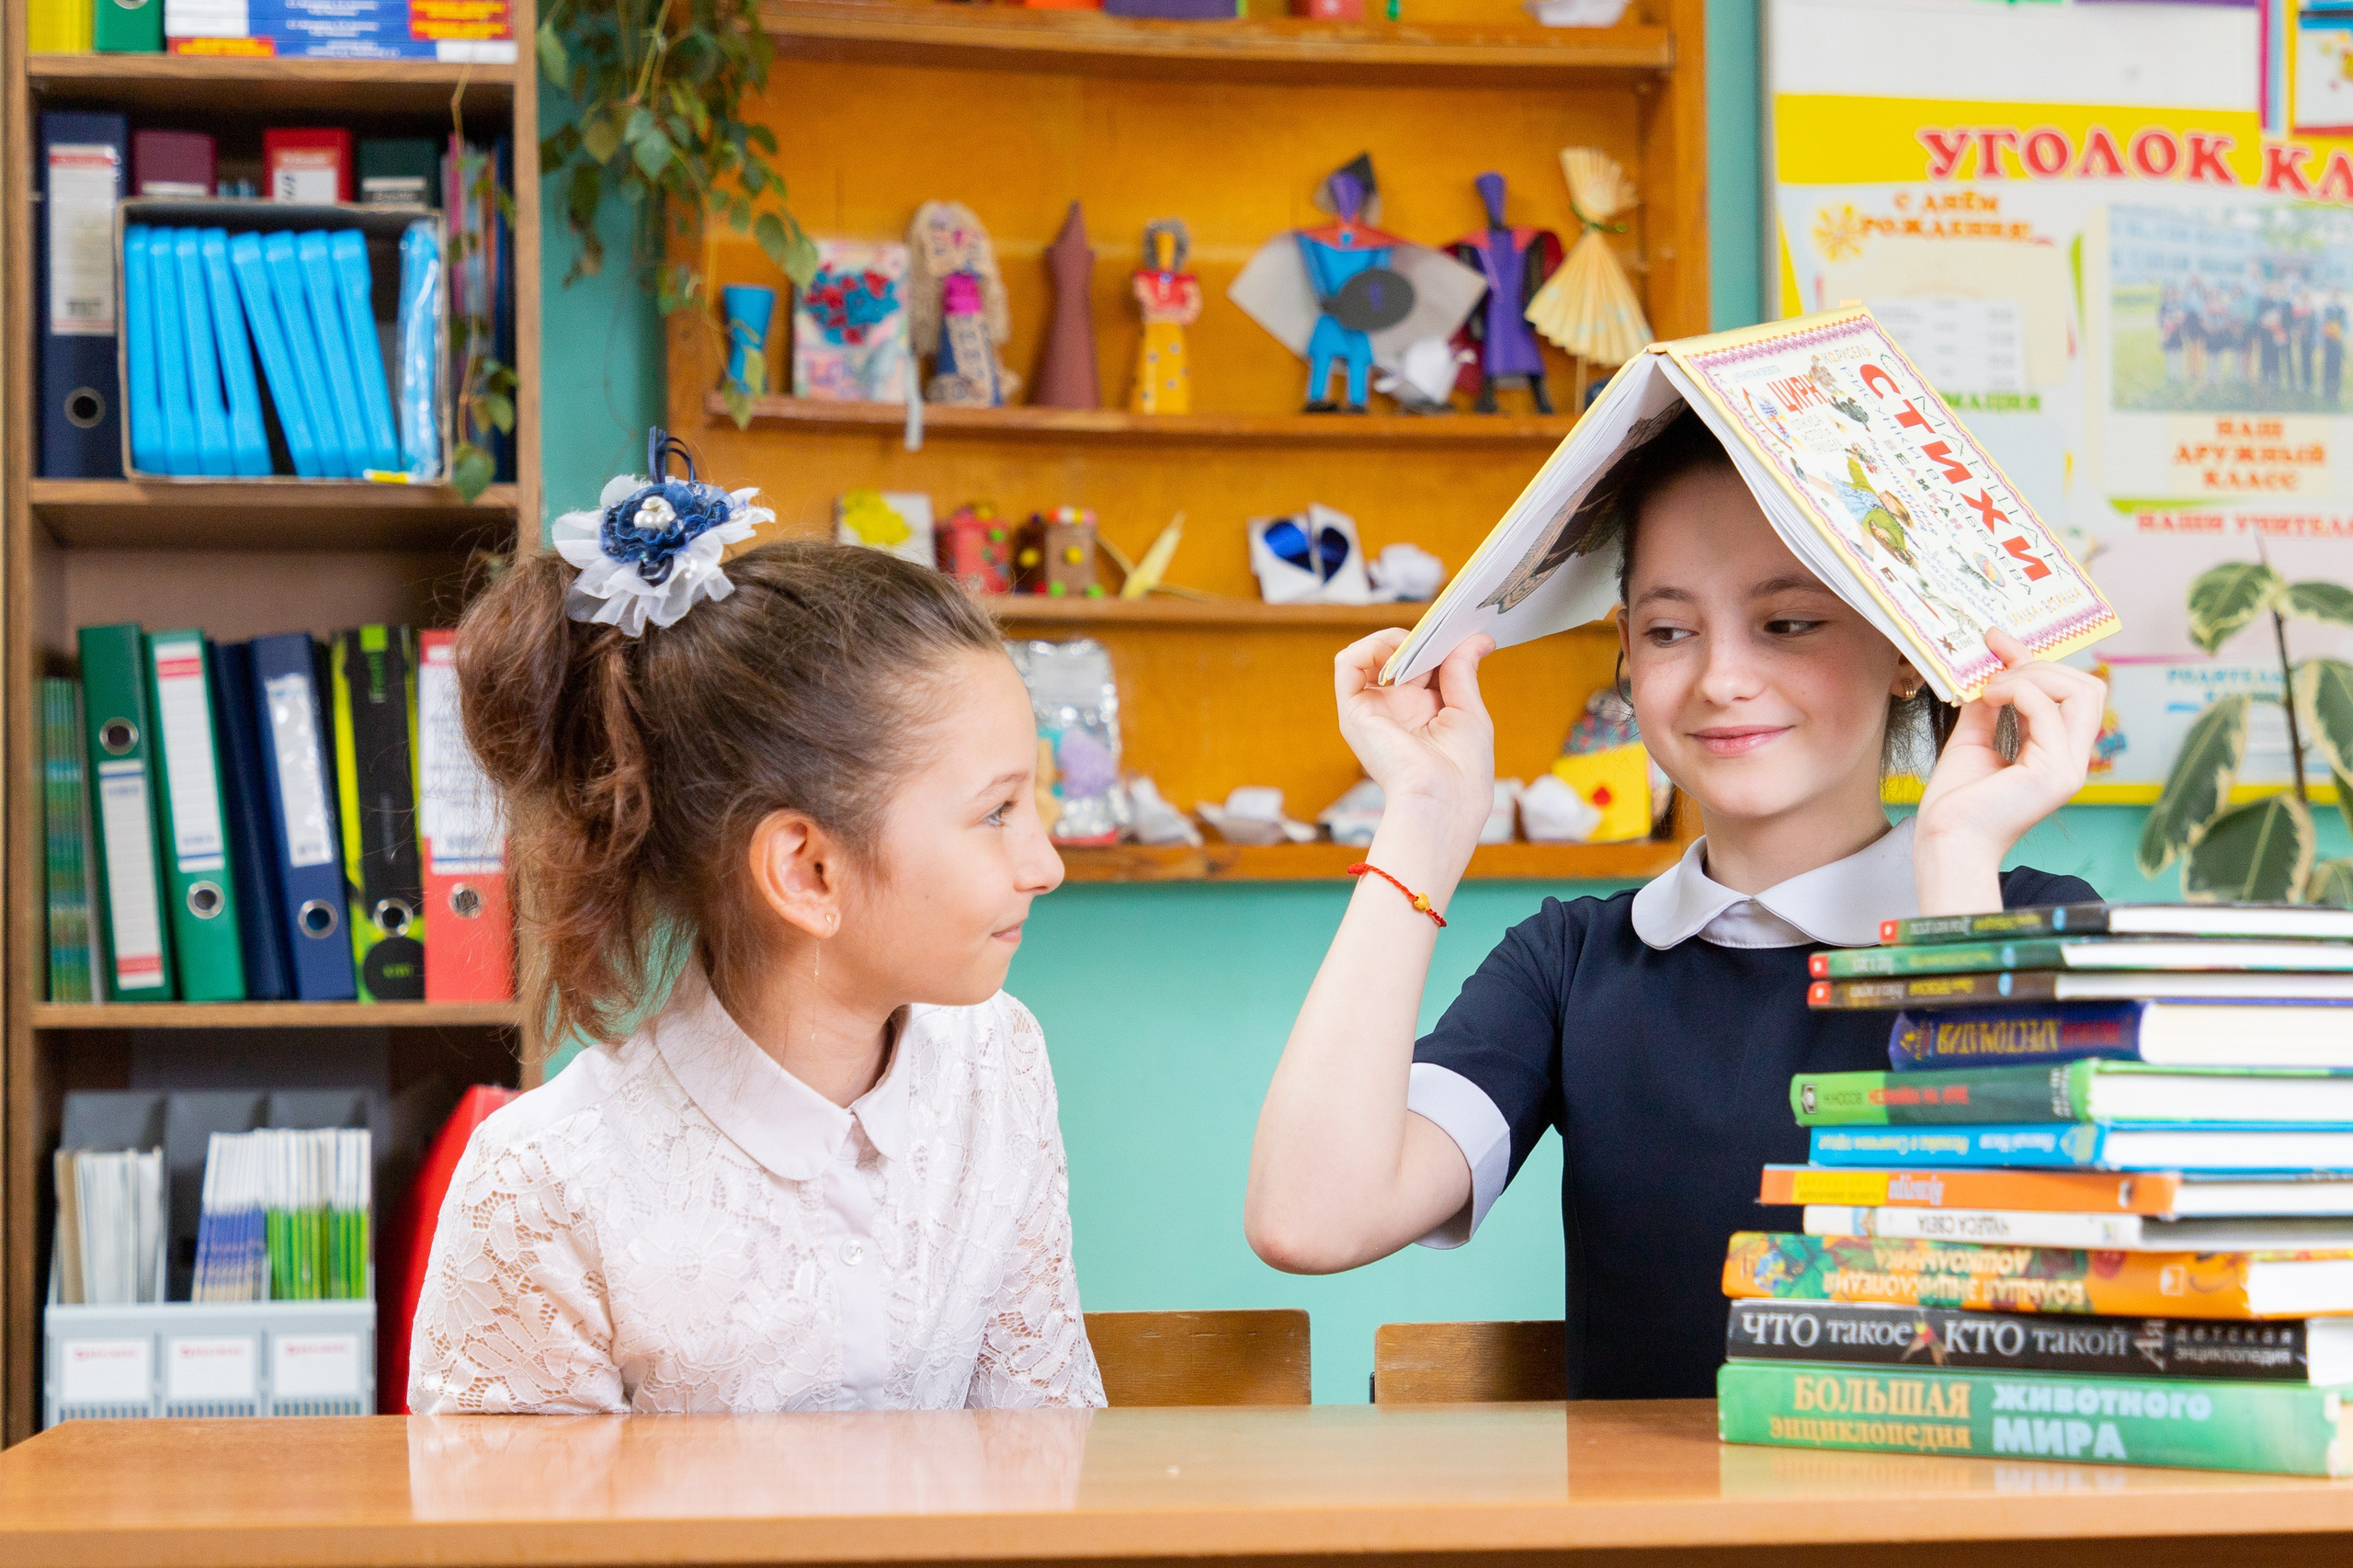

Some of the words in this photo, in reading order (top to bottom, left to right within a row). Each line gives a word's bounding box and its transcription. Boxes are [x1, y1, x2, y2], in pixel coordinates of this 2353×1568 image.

[1921, 131, 2238, 184] УГОЛОК
[1767, 374, 1828, 415] ЦИРК
[1840, 366, 1922, 460] РИСУНКИ
[1713, 373, 1784, 458] КУЗНЕЦ
[1859, 363, 2052, 582] СТИХИ
[1883, 438, 1964, 531] ВЕЛИКАН
[1913, 396, 2070, 580] МАРШАК
[1937, 1017, 2063, 1054] ХРЕСТОМАТИЯ
[1917, 1214, 1954, 1233] СВЕТА
[1960, 1215, 2010, 1237] ЧУДЕСА
[1874, 1248, 2032, 1276] ДОШКОЛЬНИКА
[1823, 1269, 1977, 1301] ЭНЦИКЛОПЕДИЯ
[1984, 1278, 2086, 1306] БОЛЬШАЯ
[1742, 1312, 1820, 1347] ЧТО
[1825, 1320, 1914, 1346] такое
[1943, 1318, 2025, 1356] КТО
[2031, 1326, 2128, 1356] такой
[1794, 1374, 1972, 1419] БОЛЬШАЯ
[1769, 1414, 1972, 1450] энциклопедия
[1992, 1415, 2128, 1460] МИРА
